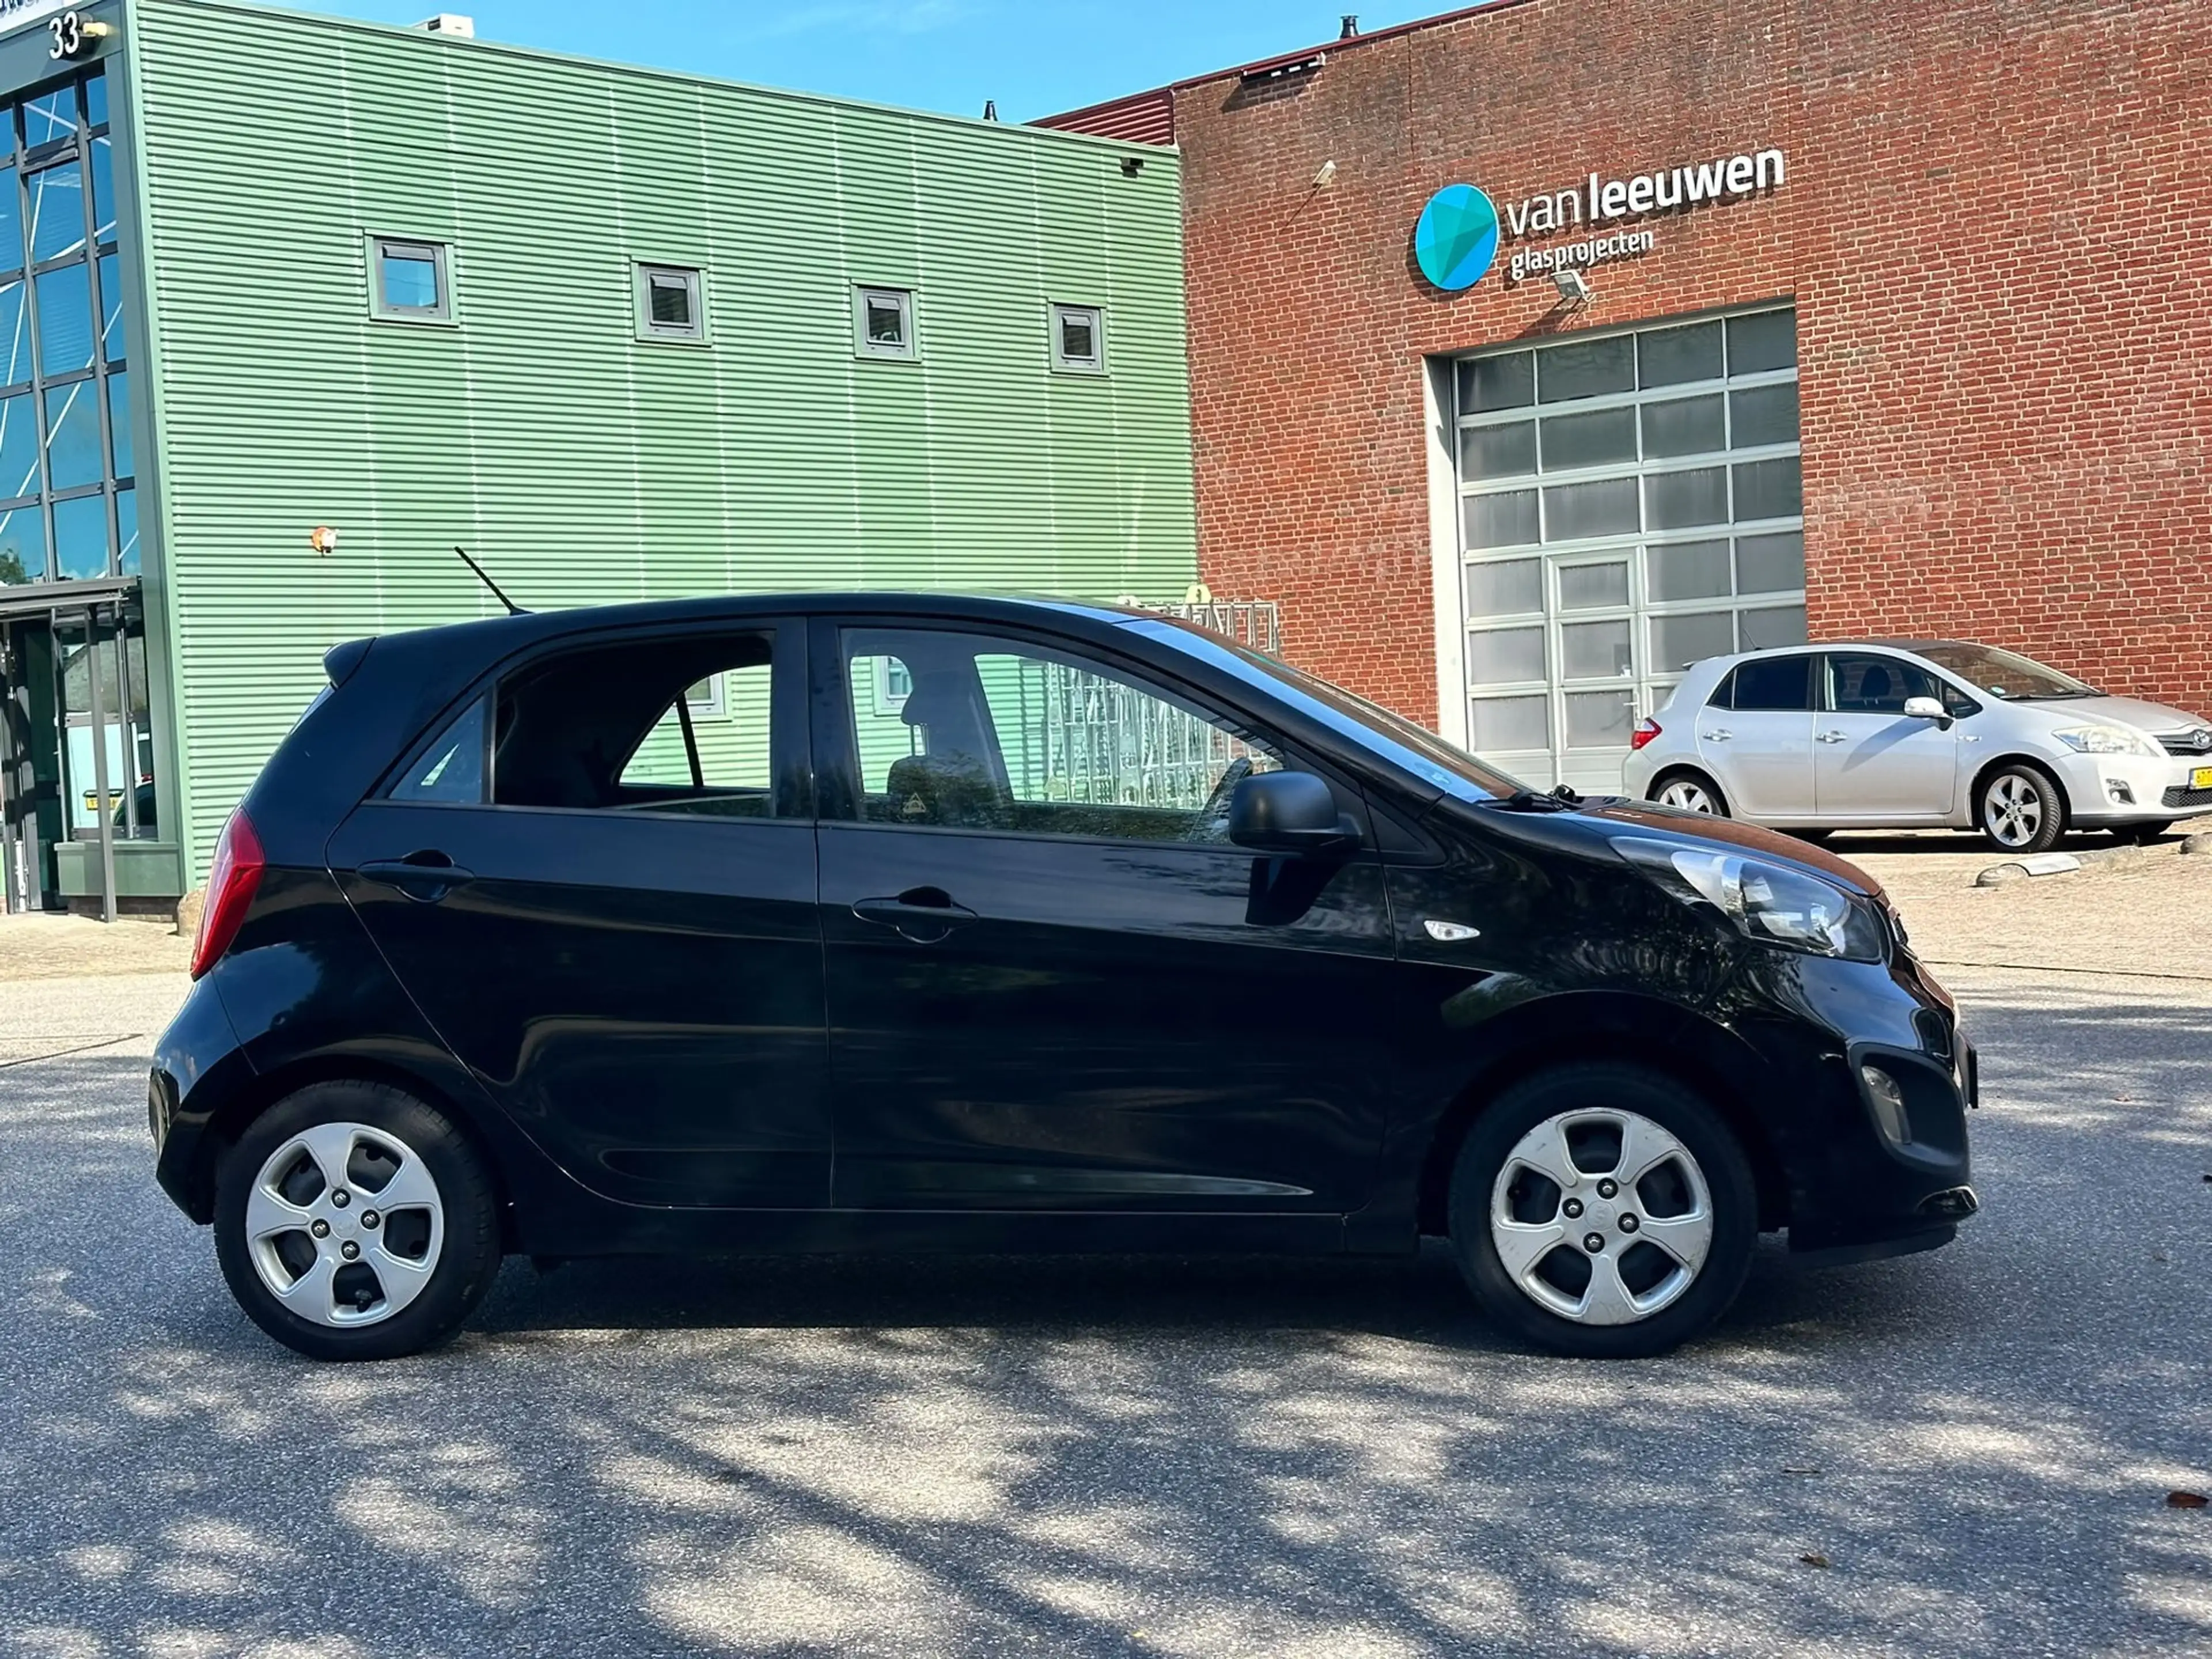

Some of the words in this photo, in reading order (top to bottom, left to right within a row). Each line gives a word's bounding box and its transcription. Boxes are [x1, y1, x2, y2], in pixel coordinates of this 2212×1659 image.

[49, 11, 79, 59] 33
[1506, 188, 1581, 236] van
[1588, 148, 1785, 220] leeuwen
[1510, 230, 1654, 281] glasprojecten
